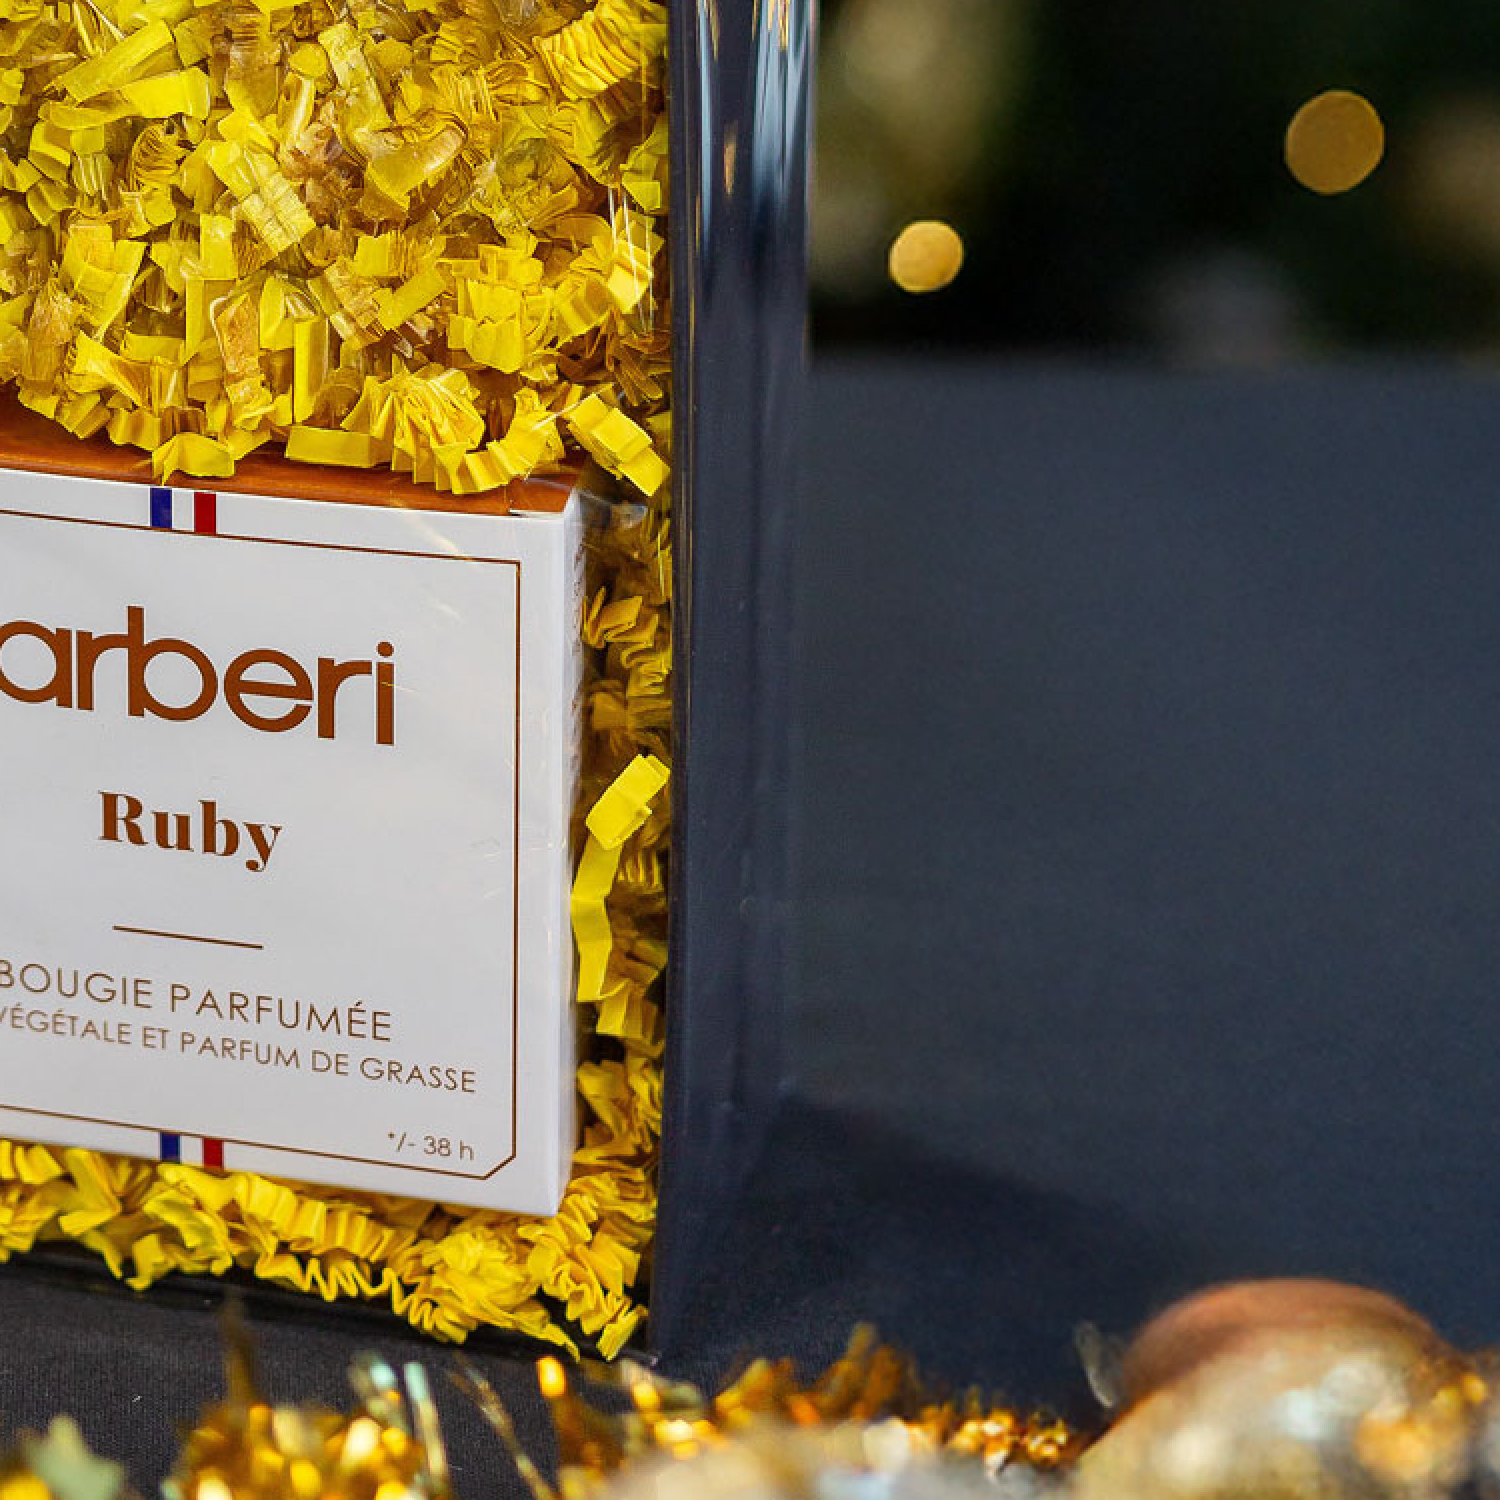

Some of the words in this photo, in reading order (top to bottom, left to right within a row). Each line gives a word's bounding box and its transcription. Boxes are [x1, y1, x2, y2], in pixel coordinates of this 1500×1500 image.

[98, 790, 282, 873] Ruby
[170, 983, 392, 1043] PARFUMÉE
[142, 1027, 169, 1050] ET
[180, 1032, 301, 1070] PARFUM
[311, 1049, 350, 1076] DE
[360, 1056, 476, 1094] GRASSE
[423, 1135, 452, 1157] 38
[459, 1139, 475, 1161] h
